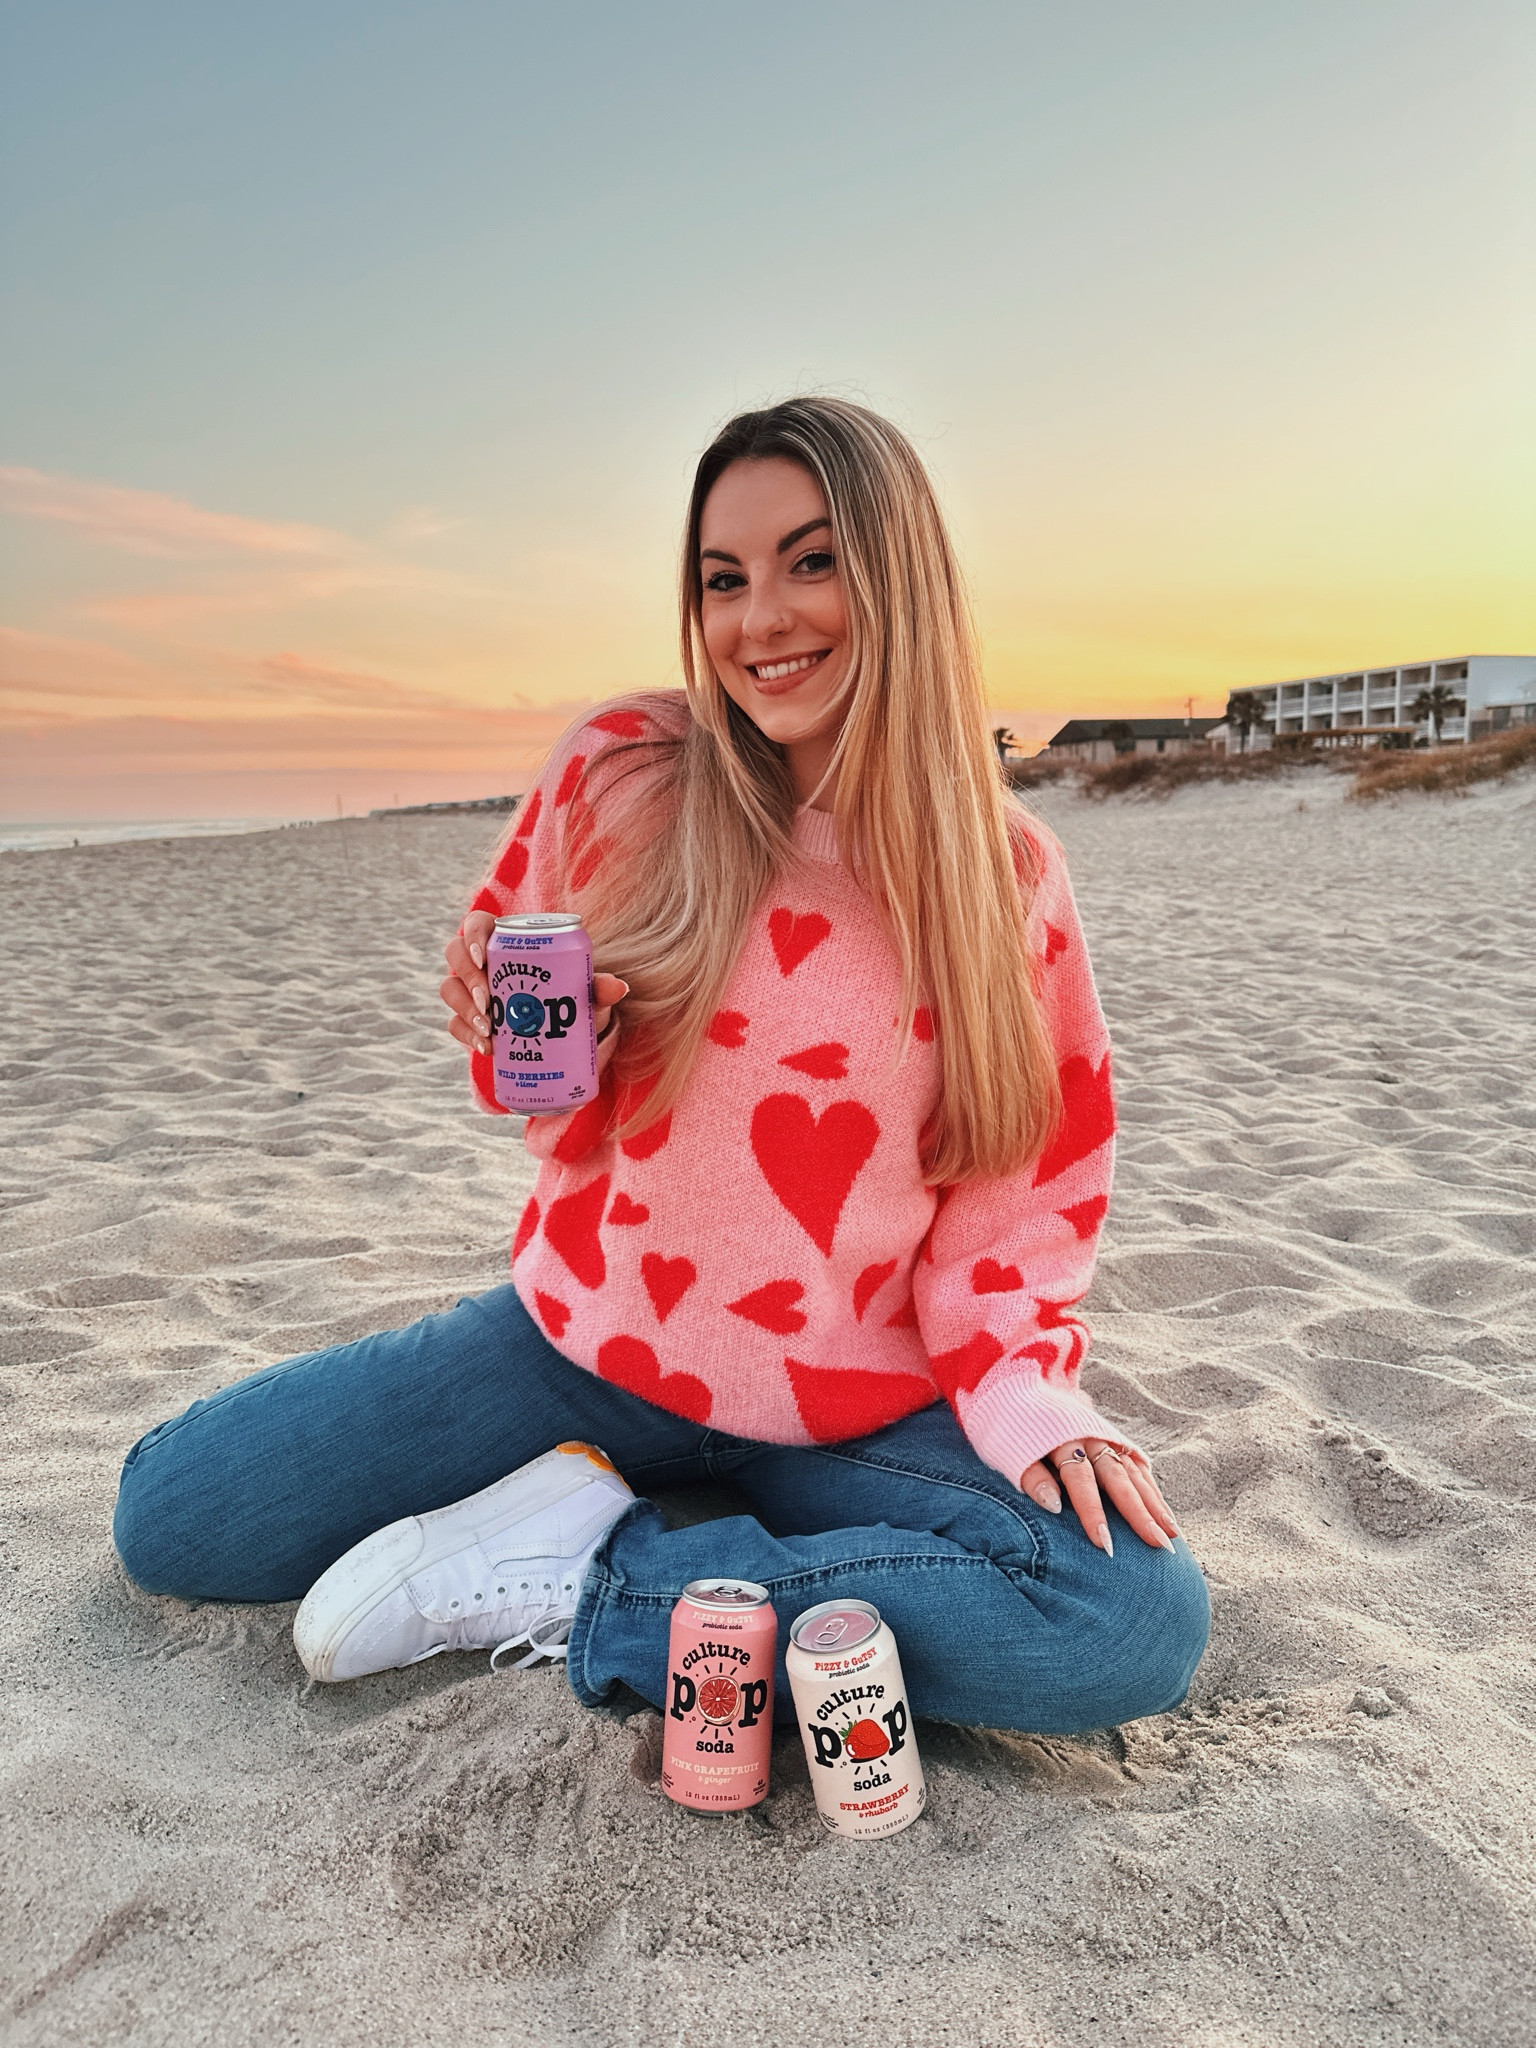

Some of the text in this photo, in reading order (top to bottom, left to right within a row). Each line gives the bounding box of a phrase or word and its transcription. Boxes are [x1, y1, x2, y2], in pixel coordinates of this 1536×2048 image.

[492, 961, 552, 989] culture
[508, 1050, 544, 1062] soda
[498, 1069, 564, 1080] WILD BERRIES
[692, 1611, 754, 1624] FiZZY & GuTSY
[682, 1641, 751, 1670] culture
[814, 1646, 878, 1671] FiZZY & GuTSY
[828, 1662, 870, 1678] probiotic soda
[670, 1672, 768, 1728] pop
[816, 1684, 884, 1720] culture
[808, 1700, 907, 1768] pop
[696, 1740, 734, 1754] soda
[671, 1756, 760, 1776] PINK GRAPEFRUIT
[704, 1776, 732, 1786] ginger
[854, 1772, 892, 1792] soda
[840, 1783, 910, 1811] STRAWBERRY
[864, 1802, 898, 1818] rhubarb
